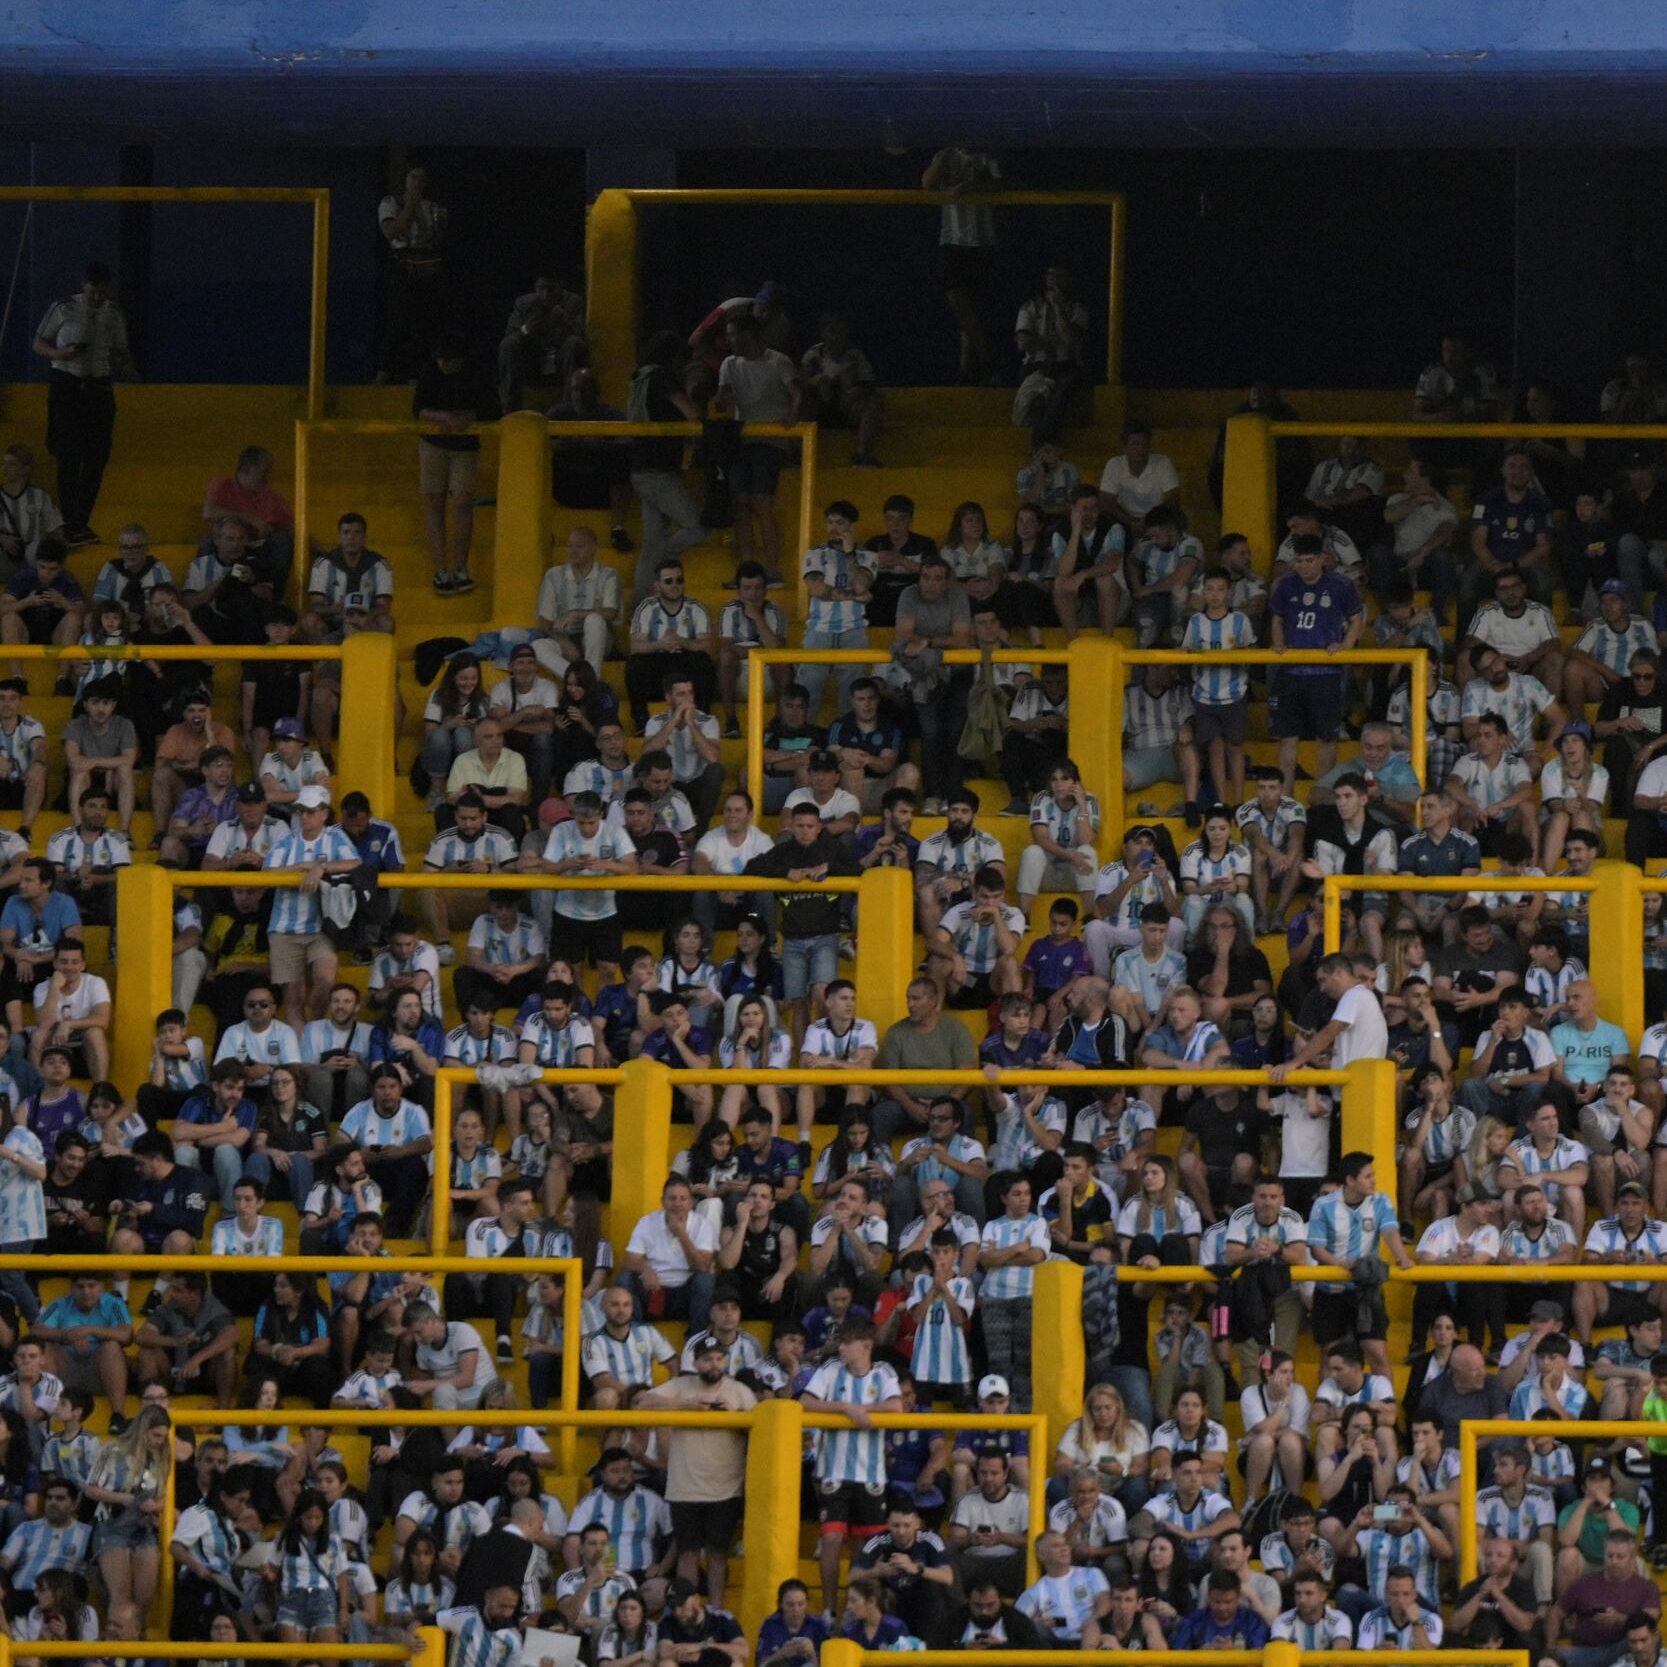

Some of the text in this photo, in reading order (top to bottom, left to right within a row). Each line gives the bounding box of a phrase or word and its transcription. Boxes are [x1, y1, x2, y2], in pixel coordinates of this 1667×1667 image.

[1296, 611, 1316, 630] 10
[1055, 826, 1071, 843] 10
[1127, 899, 1144, 921] 10
[1565, 1045, 1613, 1060] PARIS
[930, 1307, 945, 1327] 10
